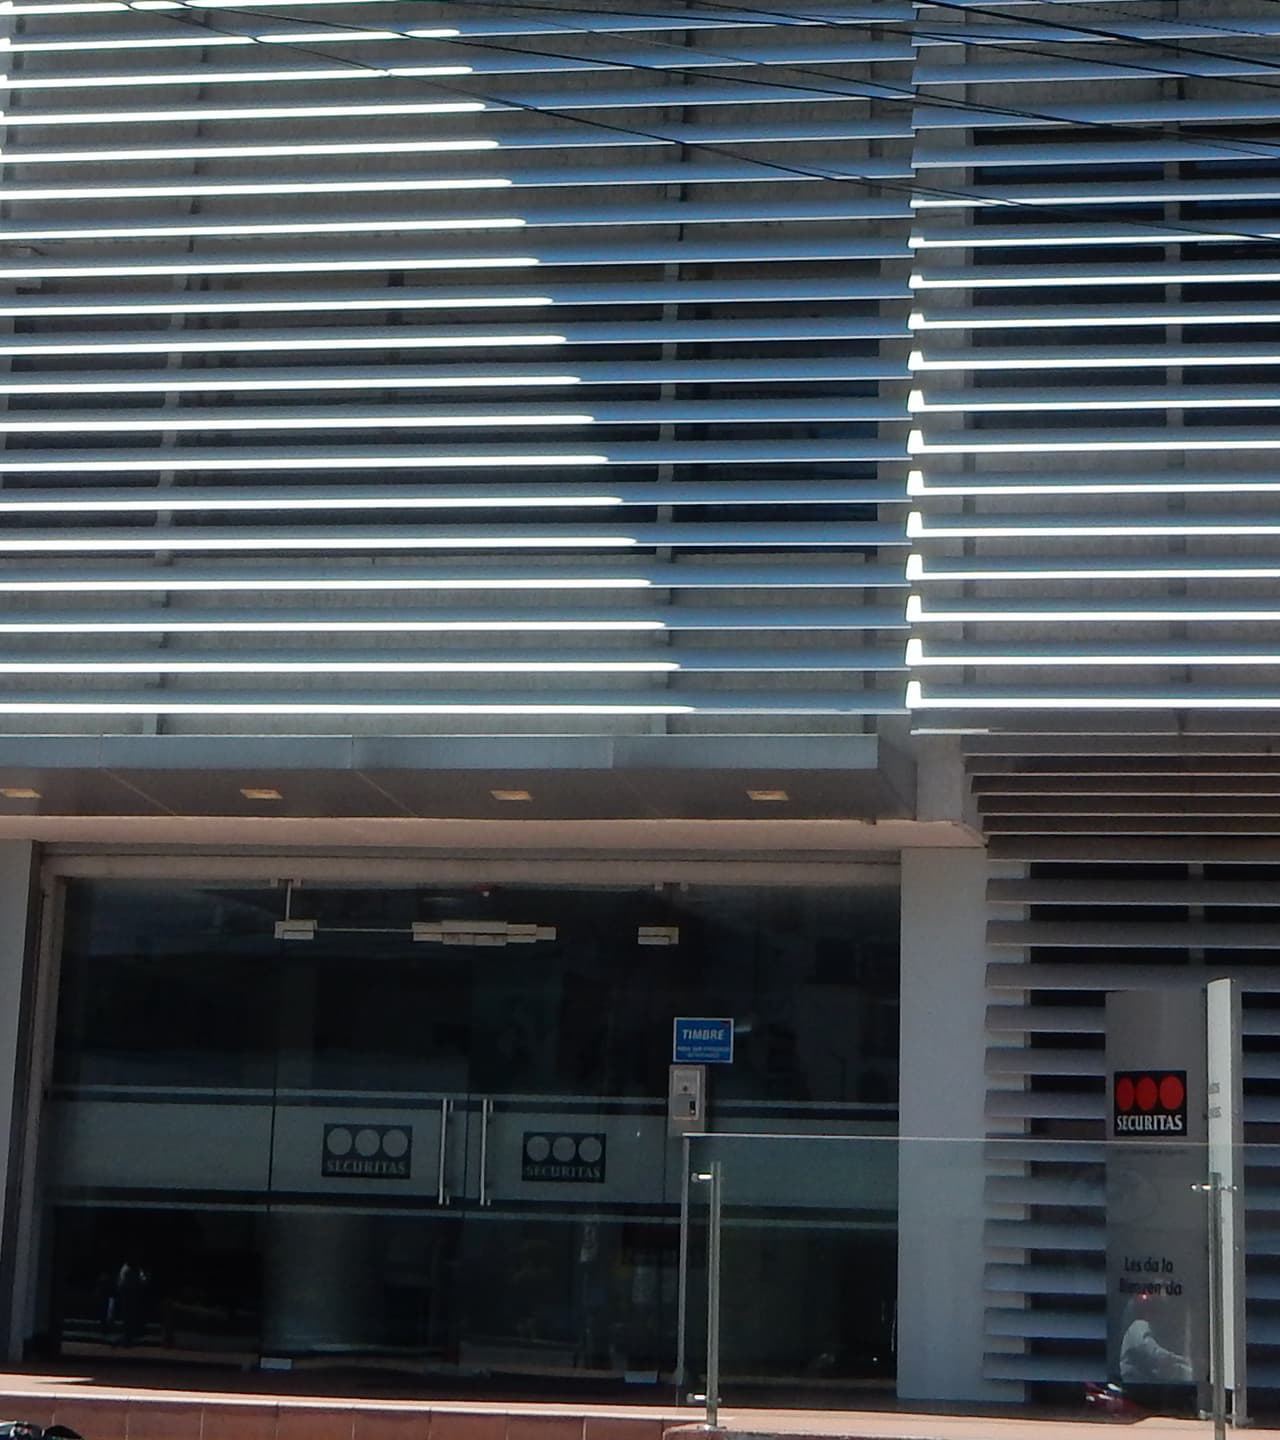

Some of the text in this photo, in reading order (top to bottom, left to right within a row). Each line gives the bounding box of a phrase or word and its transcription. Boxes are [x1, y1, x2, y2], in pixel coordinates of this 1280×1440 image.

[683, 1029, 725, 1040] TIMBRE
[1116, 1114, 1183, 1131] SECURITAS
[326, 1160, 407, 1175] SECURITAS
[525, 1164, 601, 1179] SECURITAS
